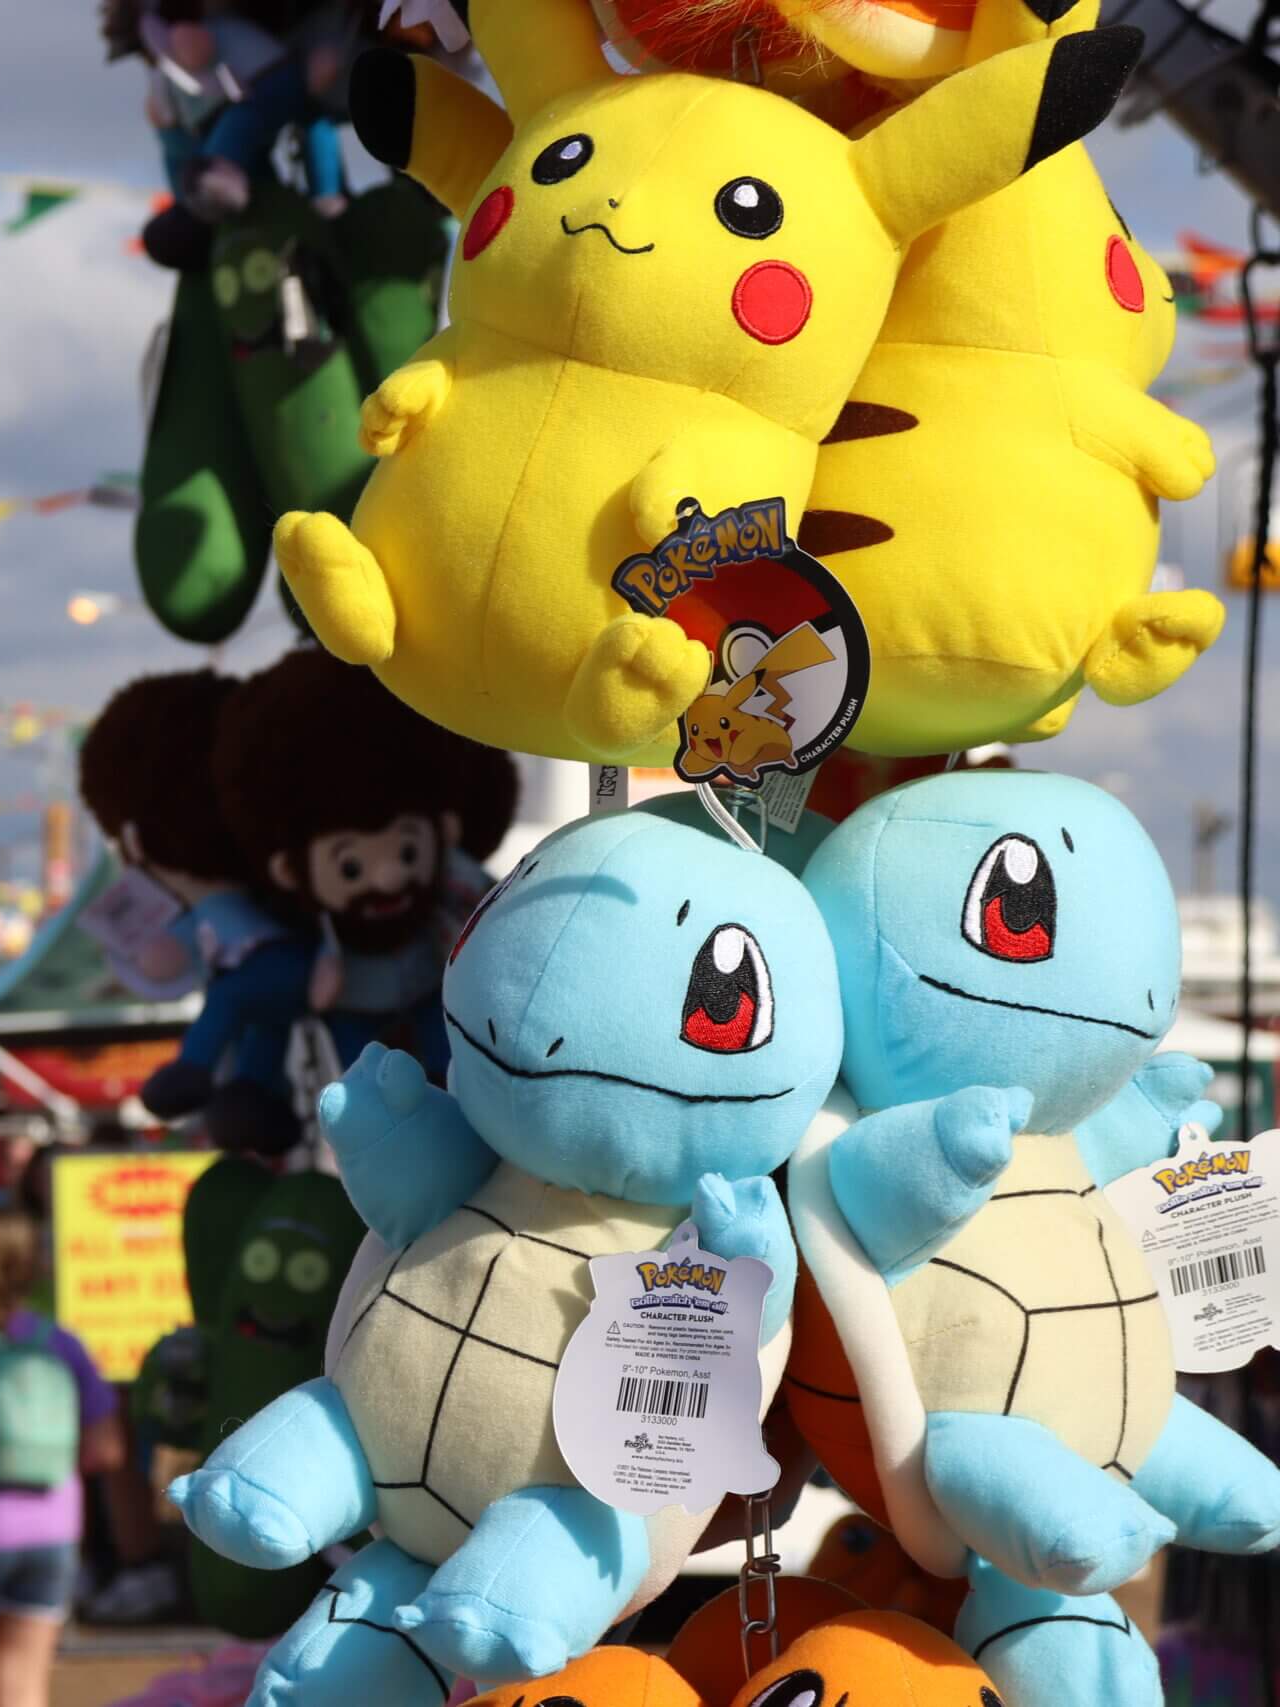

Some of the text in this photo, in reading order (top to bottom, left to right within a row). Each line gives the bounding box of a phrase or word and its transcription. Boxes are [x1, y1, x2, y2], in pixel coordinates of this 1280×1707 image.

[800, 698, 858, 763] CHARACTER PLUSH
[1170, 1200, 1223, 1219] CHARACTER
[1224, 1192, 1252, 1205] PLUSH
[640, 1311, 714, 1323] CHARACTER PLUSH
[622, 1364, 711, 1379] 9"-10" Pokemon, Asst
[640, 1414, 678, 1426] 3133000
